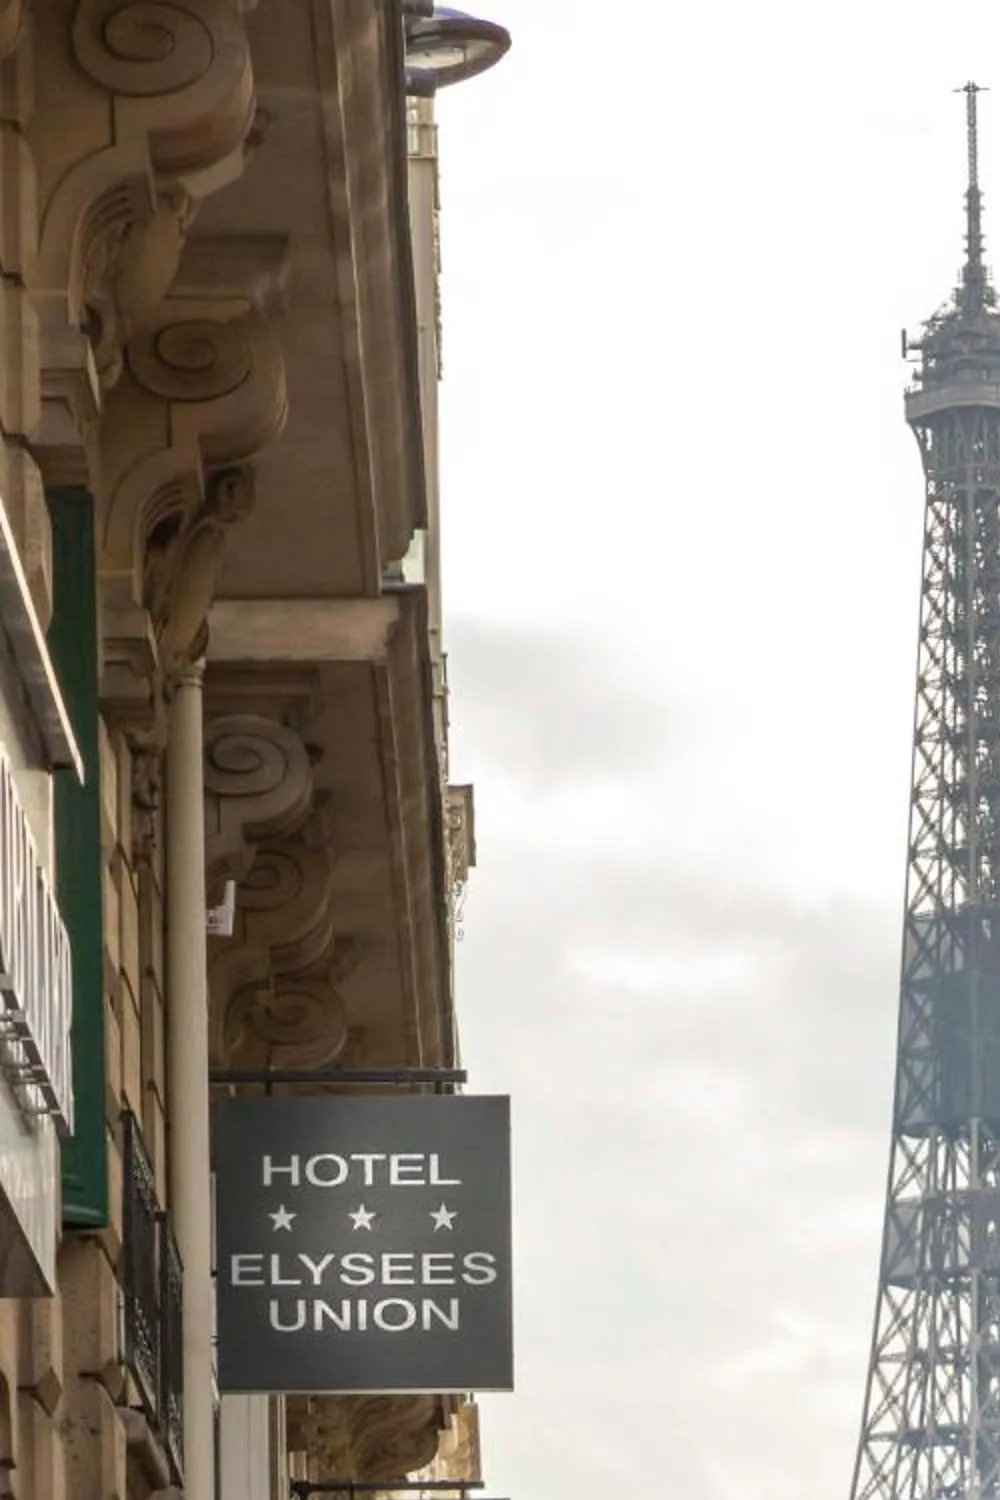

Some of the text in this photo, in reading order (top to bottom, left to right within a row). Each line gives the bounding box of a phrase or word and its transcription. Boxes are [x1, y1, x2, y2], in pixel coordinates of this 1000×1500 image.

[263, 1152, 462, 1187] HOTEL
[231, 1251, 498, 1287] ELYSEES
[269, 1296, 460, 1332] UNION
